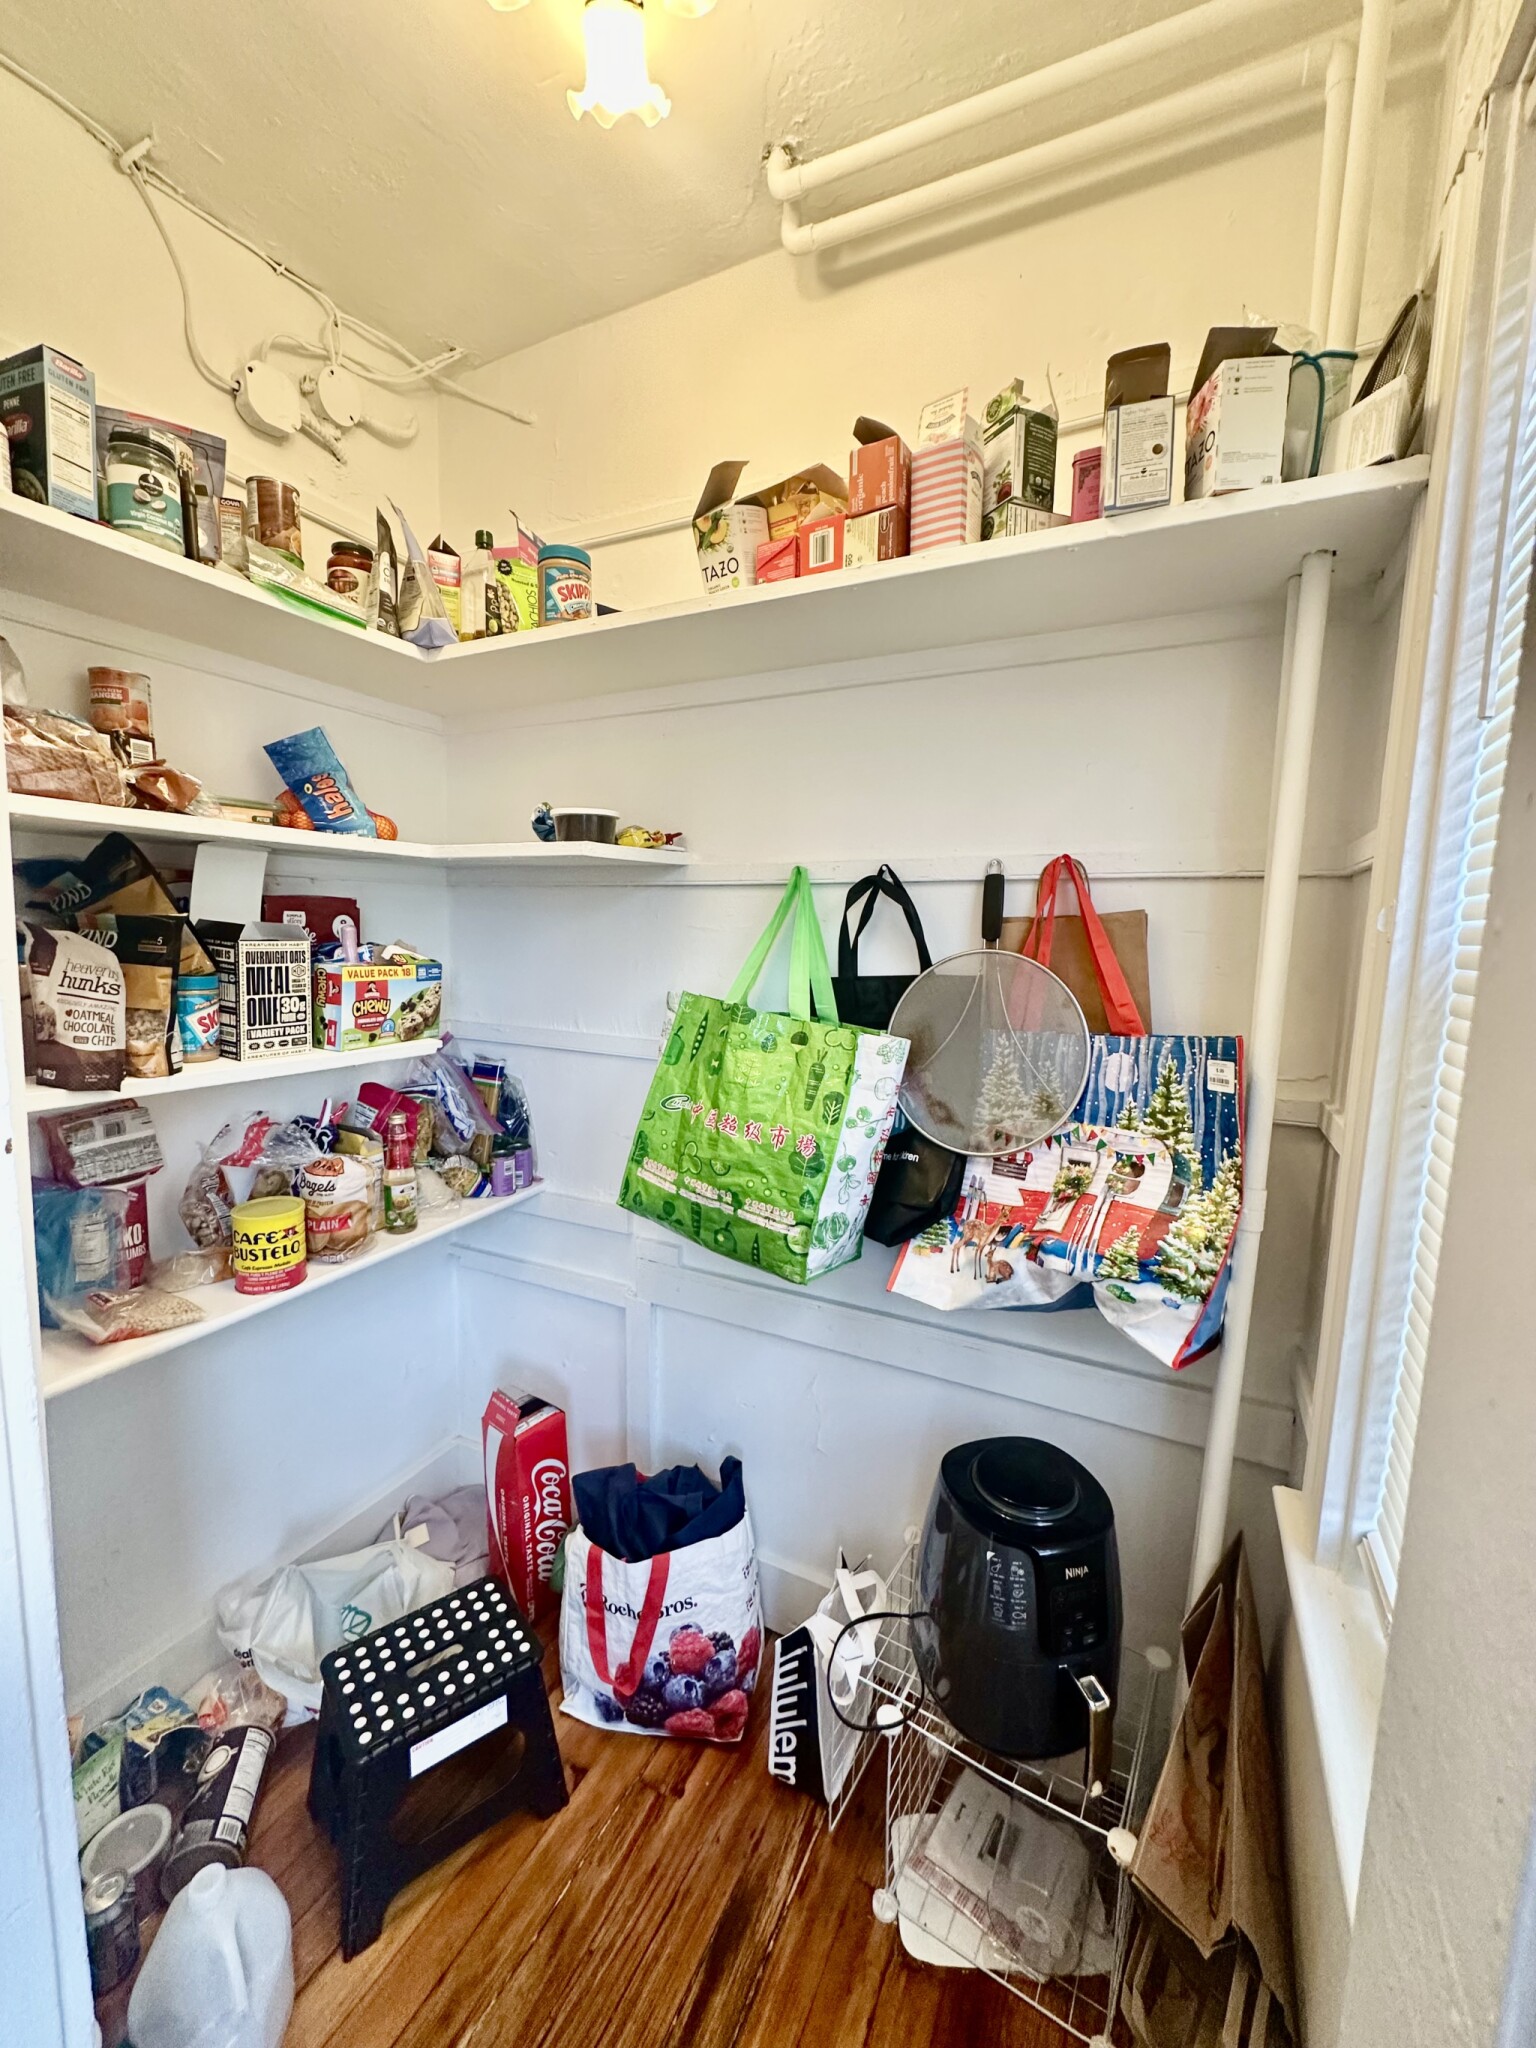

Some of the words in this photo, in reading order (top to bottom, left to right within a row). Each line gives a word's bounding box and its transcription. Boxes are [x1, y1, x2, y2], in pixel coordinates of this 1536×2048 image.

[18, 367, 35, 385] FREE
[7, 418, 28, 436] arilla
[857, 473, 866, 510] organic
[702, 557, 739, 583] TAZO
[526, 589, 539, 630] ACHIOS
[50, 883, 92, 912] KIND
[245, 950, 288, 965] OVERNIGHT
[289, 950, 306, 964] OATS
[58, 971, 122, 996] hunks
[246, 966, 291, 996] MEAL
[347, 969, 376, 979] VALUE
[377, 968, 399, 978] PACK
[401, 967, 411, 977] 18
[73, 1009, 115, 1025] OATMEAL
[247, 996, 279, 1027] ONE
[63, 1020, 116, 1036] CHOCOLATE
[251, 1027, 284, 1039] VARIETY
[285, 1025, 306, 1037] PACK
[91, 1035, 117, 1047] CHIP
[299, 1172, 337, 1197] Bagels
[123, 1223, 143, 1248] KO
[308, 1218, 339, 1232] PLAIN
[233, 1241, 301, 1262] BUSTELO
[522, 1495, 532, 1542] ORIGINAL
[525, 1543, 534, 1572] TASTE
[1065, 1565, 1089, 1580] NINJA
[658, 1596, 698, 1619] ros.
